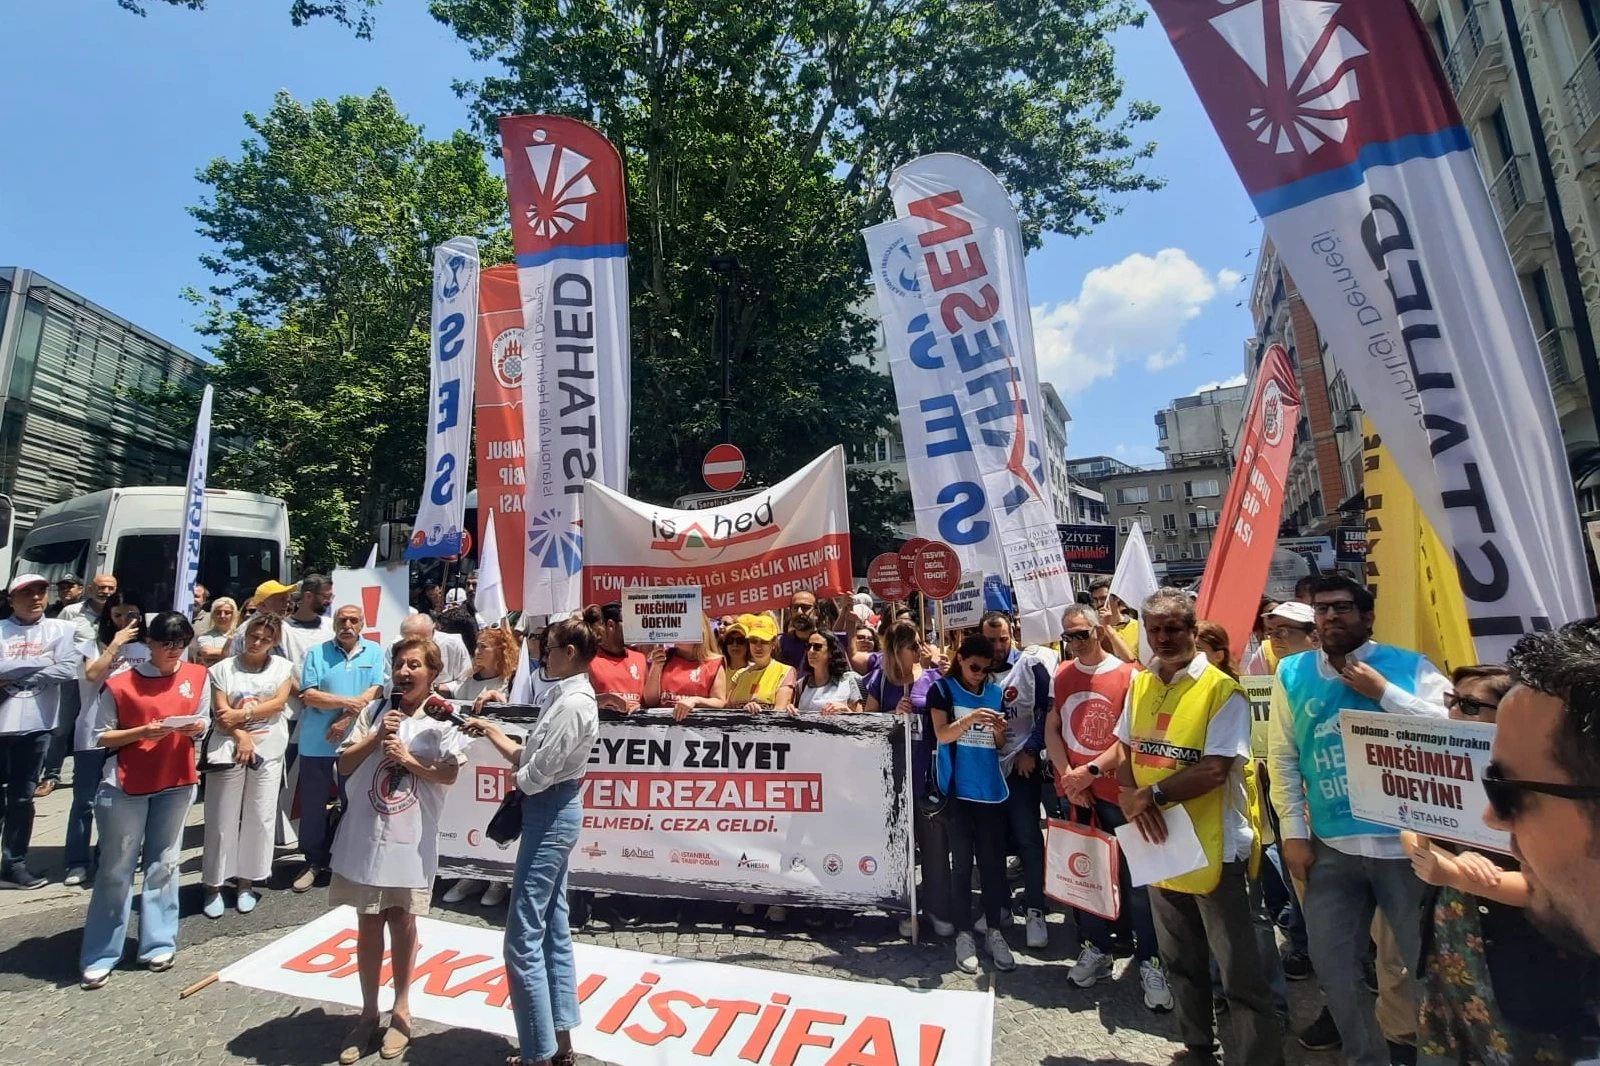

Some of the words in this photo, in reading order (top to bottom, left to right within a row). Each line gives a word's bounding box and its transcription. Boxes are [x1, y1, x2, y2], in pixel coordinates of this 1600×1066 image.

[593, 572, 625, 591] TÜM
[667, 568, 726, 588] SAĞLIĞI
[730, 559, 785, 582] SAĞLIK
[788, 544, 841, 572] MEMURU
[922, 551, 945, 561] TEŞVİK
[635, 601, 687, 615] EMEĞİMİZİ
[716, 590, 736, 608] VE
[740, 586, 770, 604] EBE
[641, 615, 682, 629] ÖDEYİN!
[1352, 724, 1389, 738] toplama
[1396, 730, 1447, 746] çıkarmayı
[1449, 735, 1490, 751] bırakın
[1365, 743, 1474, 782] EMEĞİMİZİ
[648, 779, 820, 810] REZALET!
[1381, 769, 1464, 811] ÖDEYİN!
[582, 813, 654, 831] ELMEDİ.
[661, 817, 710, 832] CEZA
[717, 815, 778, 833] GELDİ.
